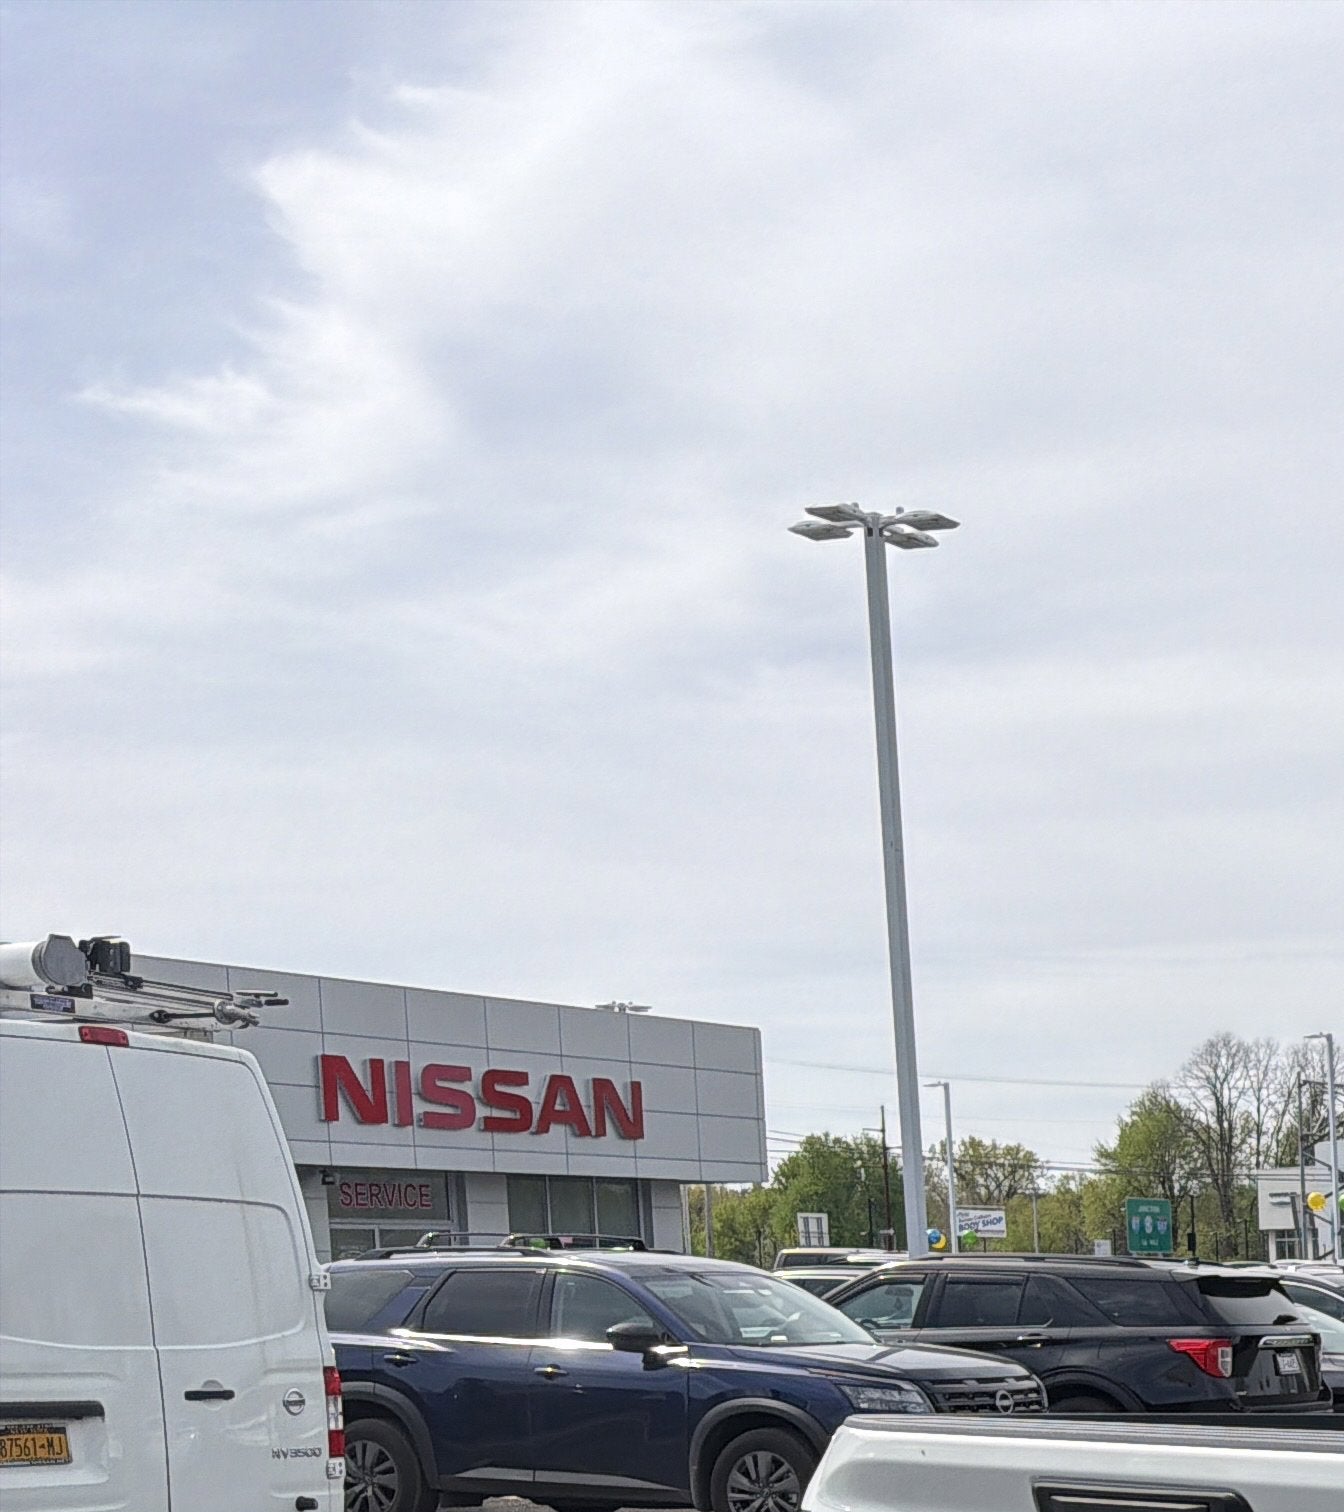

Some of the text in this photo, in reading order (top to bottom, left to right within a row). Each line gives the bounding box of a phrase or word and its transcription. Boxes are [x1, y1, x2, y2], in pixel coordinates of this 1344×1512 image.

[317, 1053, 645, 1141] NISSAN
[339, 1181, 433, 1209] SERVICE
[981, 1215, 1004, 1228] SHOP
[271, 1446, 323, 1460] NV3500
